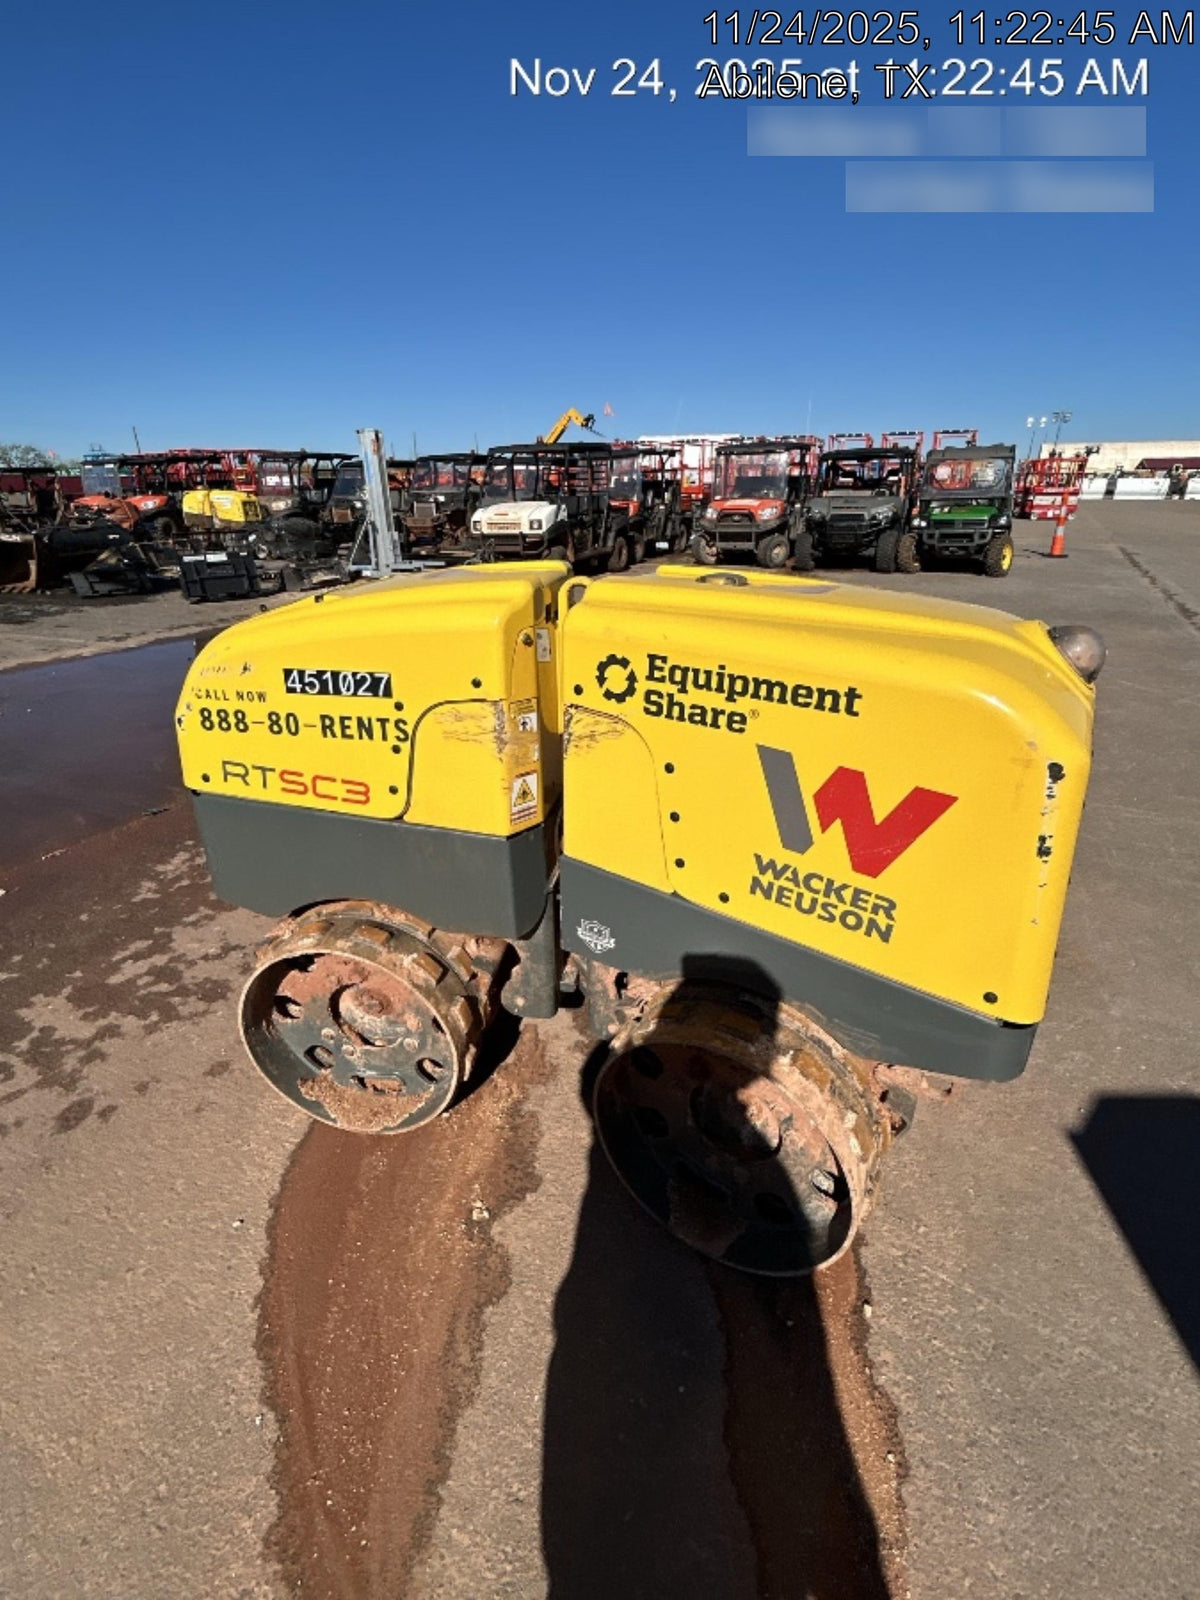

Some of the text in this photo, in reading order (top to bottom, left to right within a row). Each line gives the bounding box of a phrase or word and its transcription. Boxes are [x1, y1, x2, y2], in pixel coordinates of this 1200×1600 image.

[194, 687, 267, 703] CALL NOW
[286, 669, 390, 697] 451027
[645, 653, 863, 717] Equipment
[199, 707, 410, 743] 888-80-RENTS
[221, 759, 371, 805] RTSC3
[750, 875, 894, 944] NEUSON
[753, 852, 897, 922] WACKER
